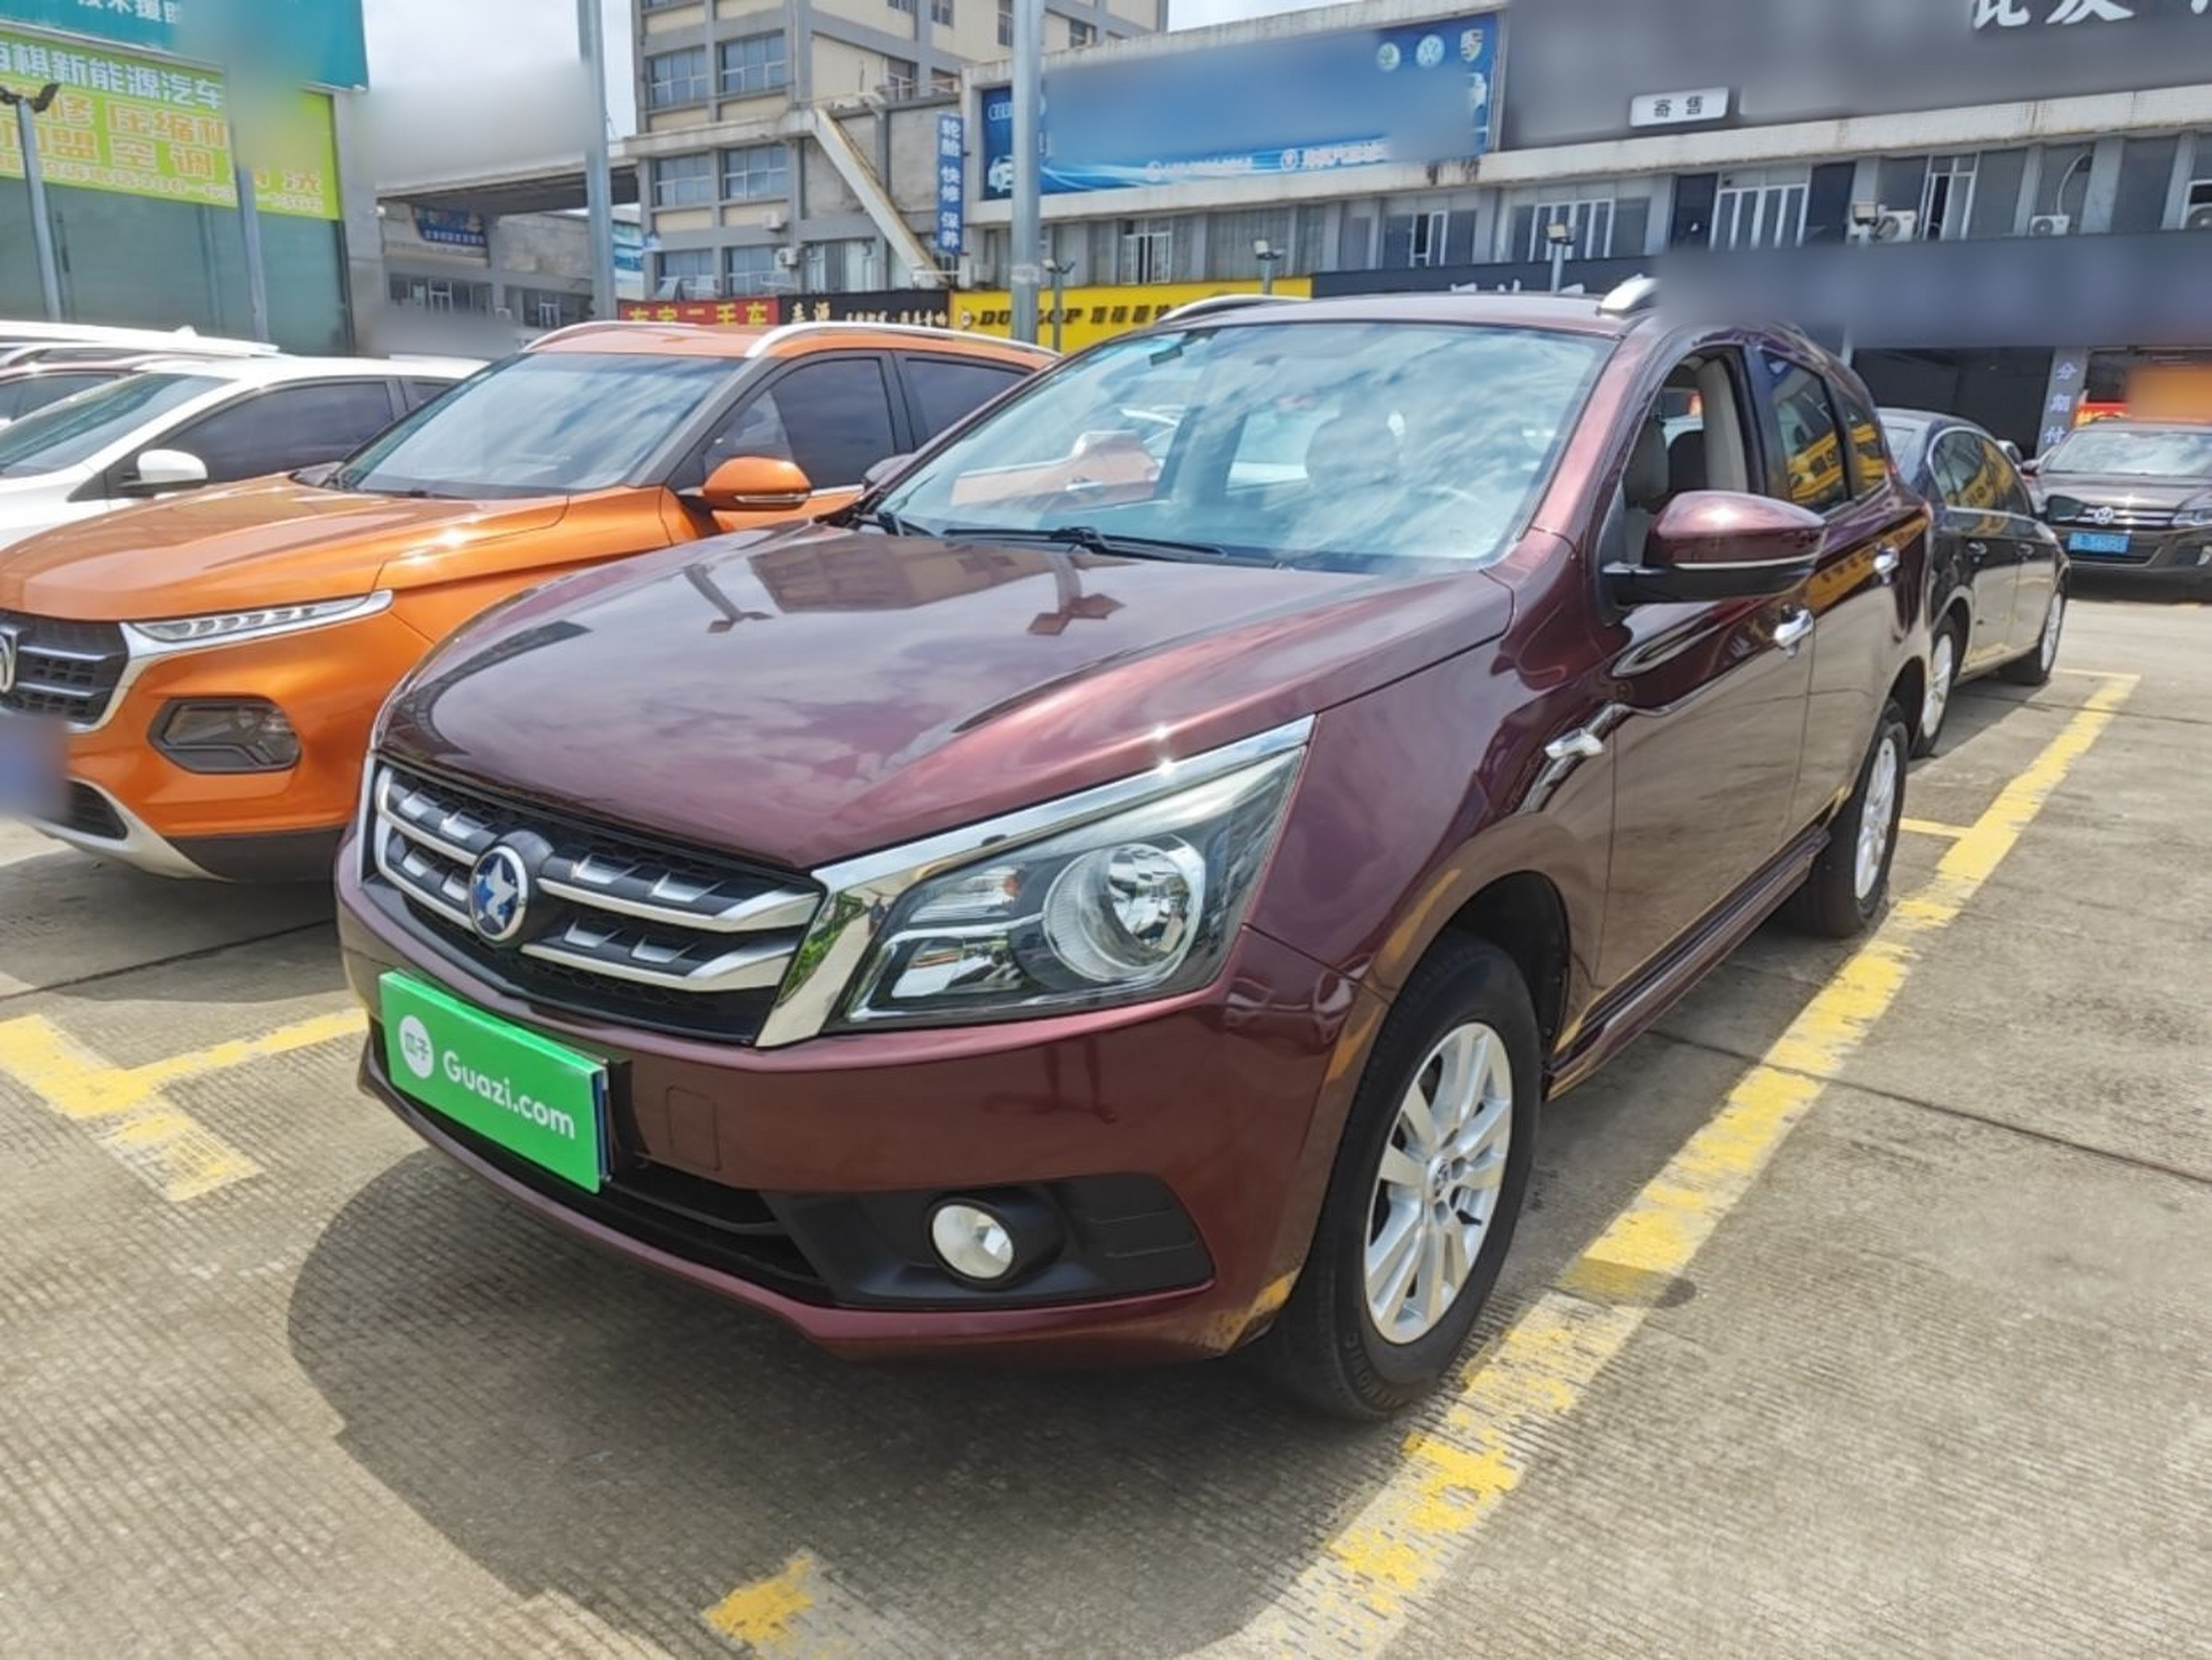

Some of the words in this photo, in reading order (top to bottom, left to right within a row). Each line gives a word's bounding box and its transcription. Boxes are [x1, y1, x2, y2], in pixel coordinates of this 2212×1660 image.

[1654, 96, 1703, 118] 寄售
[941, 120, 961, 157] 轮胎
[941, 167, 961, 202] 快修
[941, 212, 960, 248] 保养
[443, 1050, 575, 1140] Guazi.com
